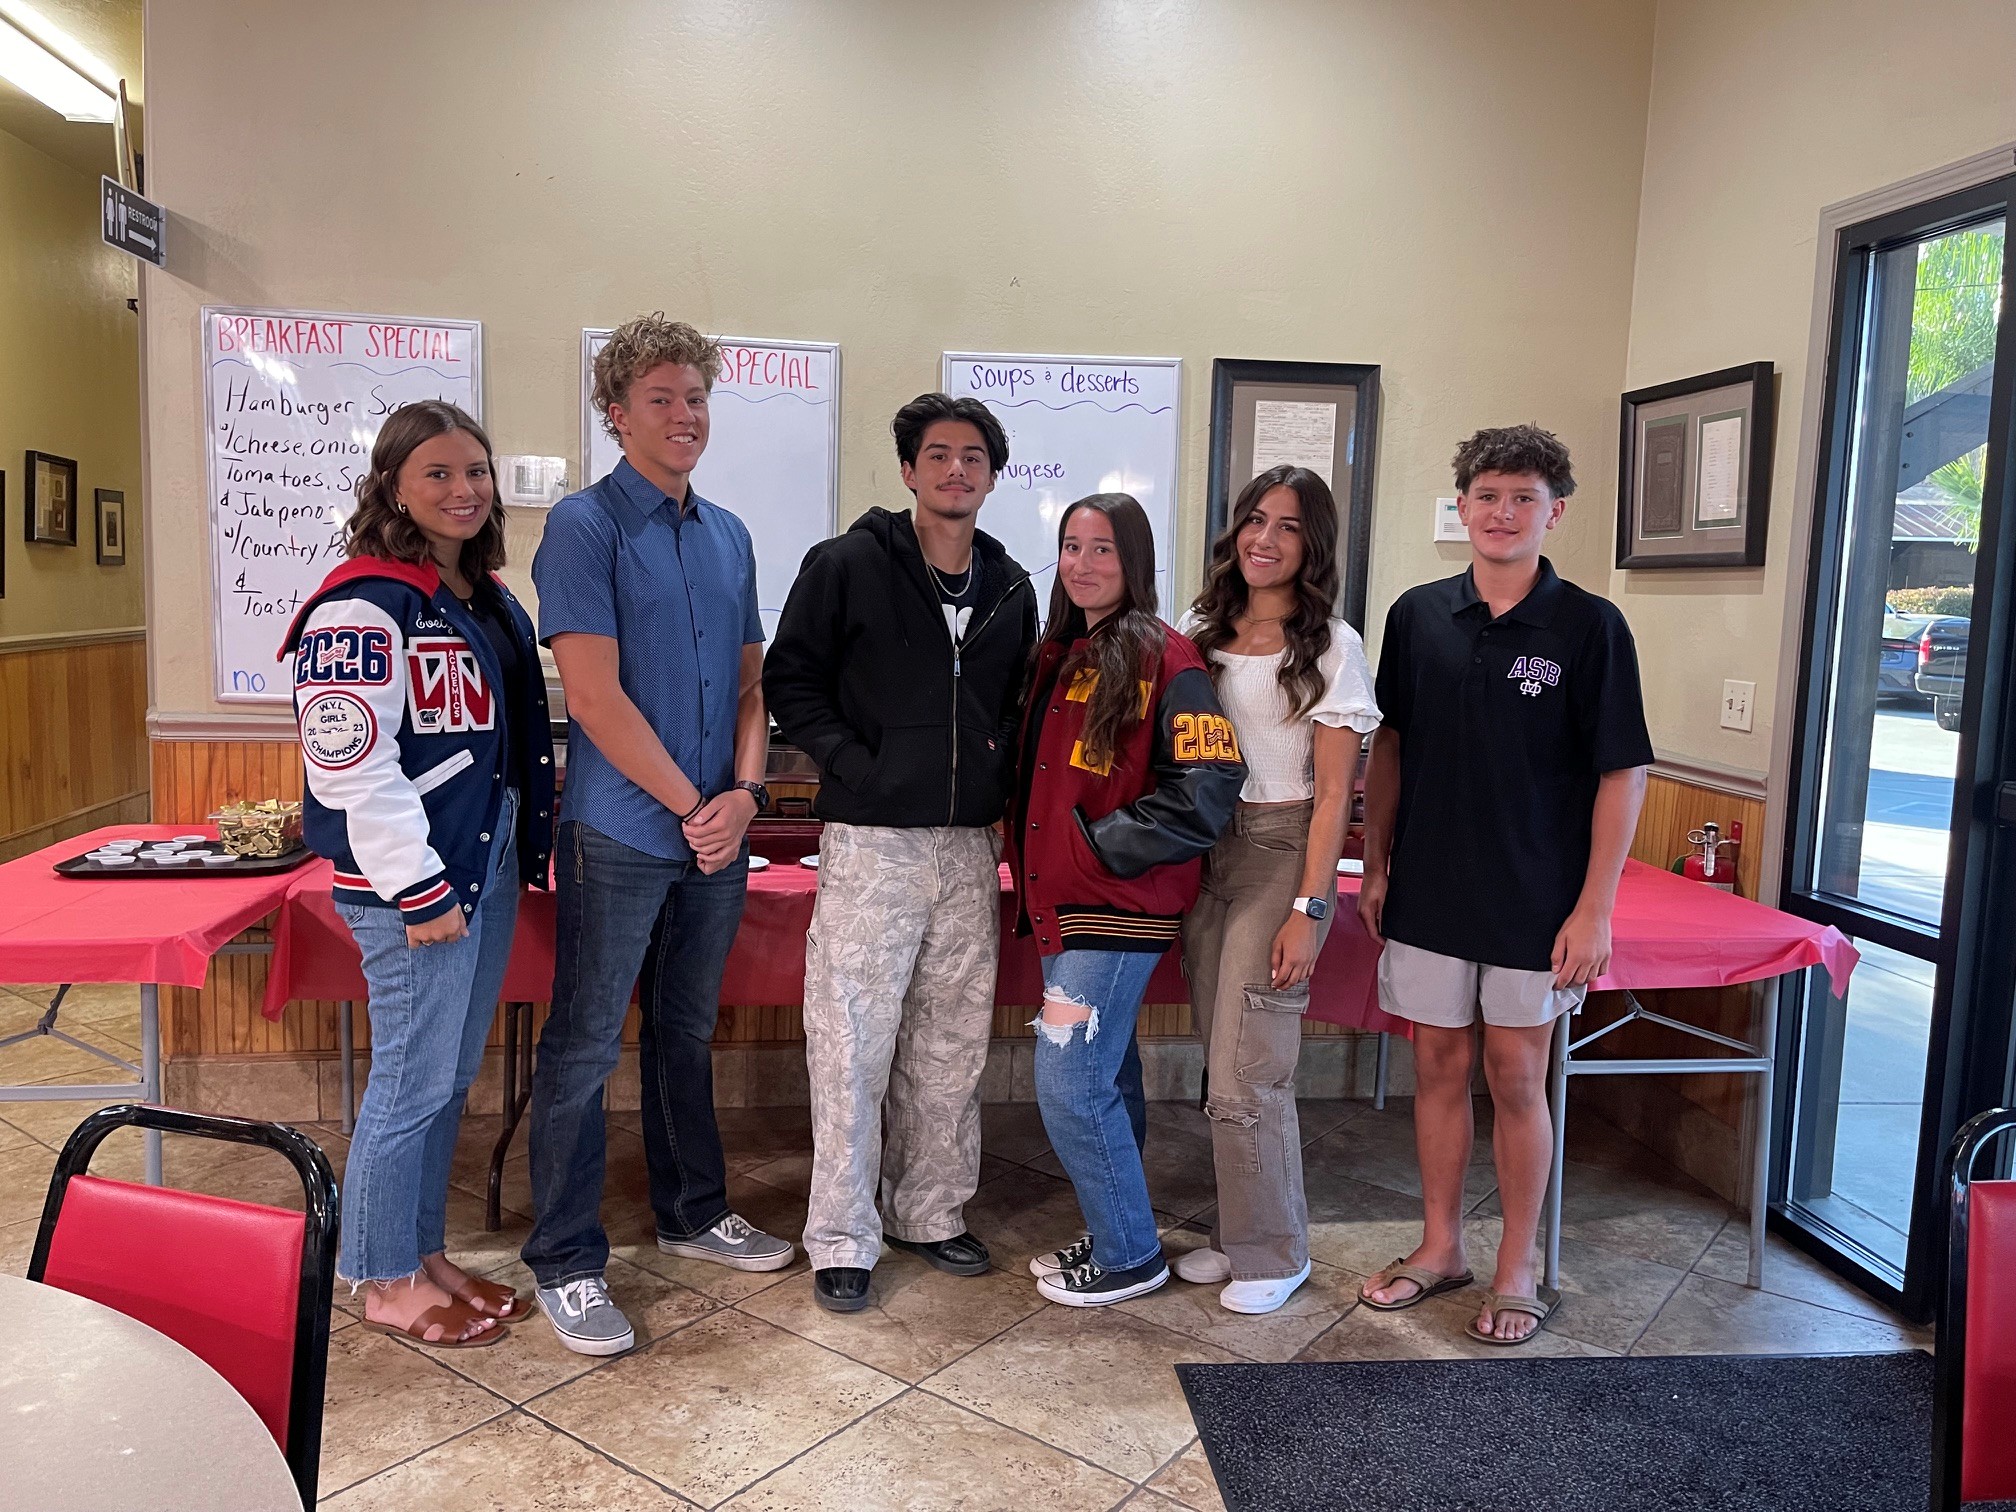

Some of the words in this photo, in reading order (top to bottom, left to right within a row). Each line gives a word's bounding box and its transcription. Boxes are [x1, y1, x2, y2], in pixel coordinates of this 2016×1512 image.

[218, 316, 353, 354] BREAKFAST
[365, 325, 461, 362] SPECIAL
[718, 347, 819, 389] SPECIAL
[970, 364, 1035, 397] Soups
[1061, 365, 1140, 395] desserts
[226, 374, 355, 425] Hamburger
[232, 589, 305, 617] Toast
[295, 627, 391, 689] 2026
[1507, 656, 1561, 687] ASB
[233, 670, 266, 693] no
[448, 649, 461, 718] ACADEMICS
[307, 727, 317, 736] 20
[353, 723, 364, 732] 23
[320, 713, 347, 724] GIRLS
[311, 736, 362, 758] CHAMPIONS
